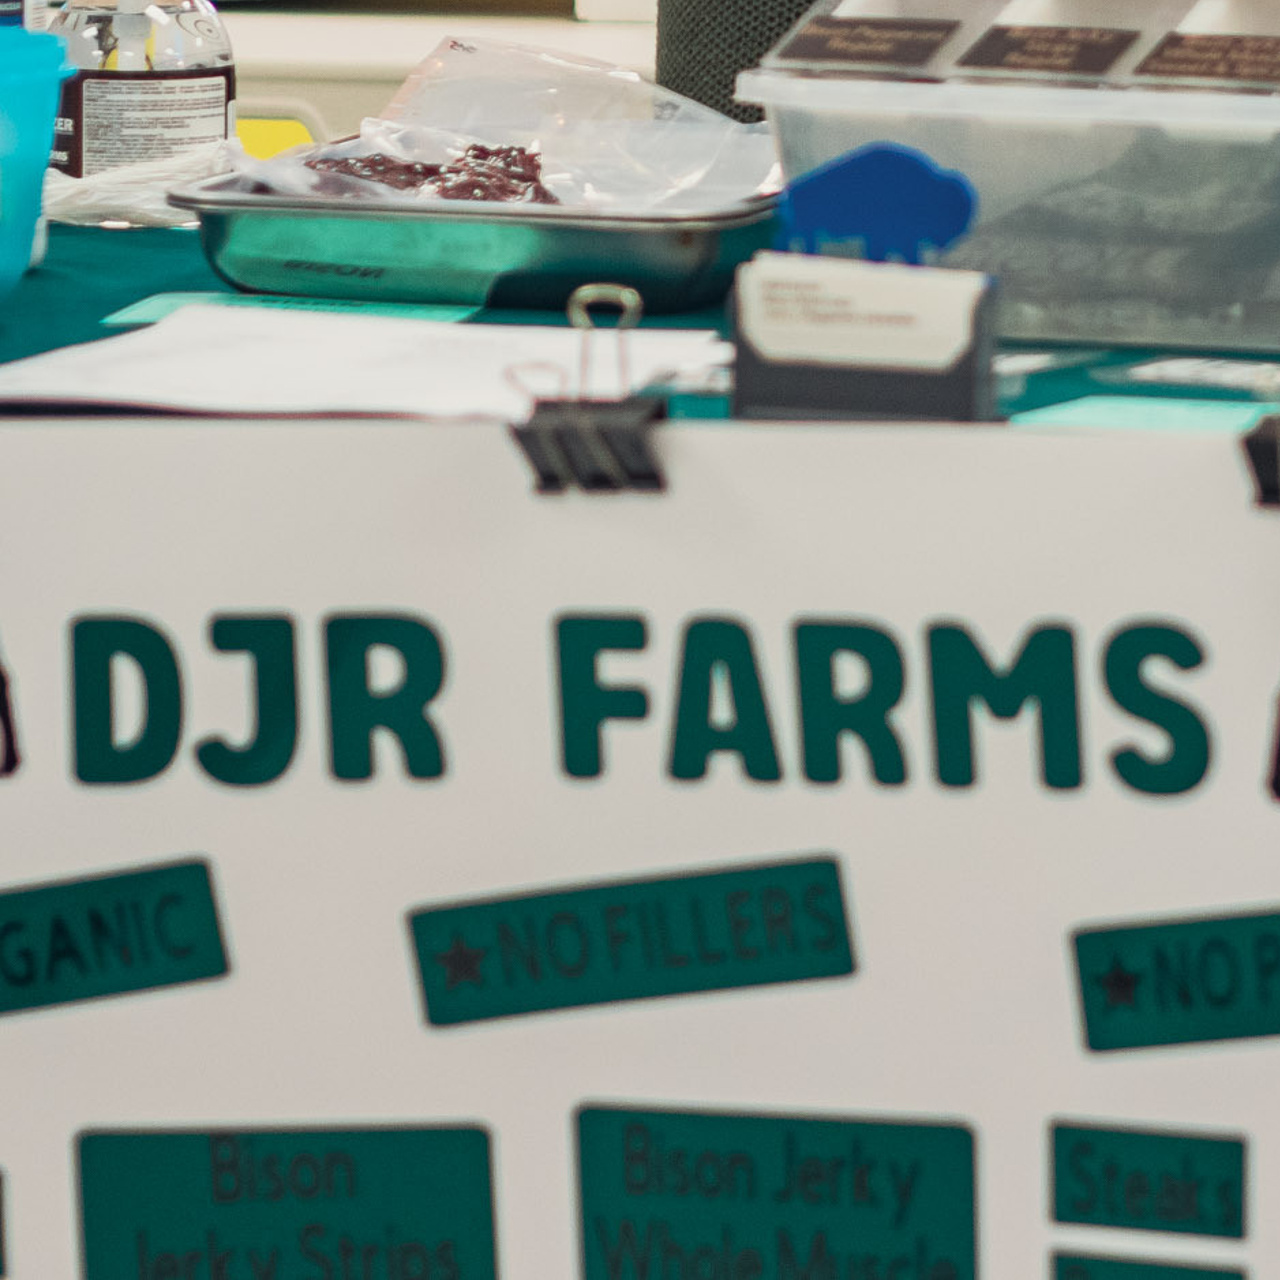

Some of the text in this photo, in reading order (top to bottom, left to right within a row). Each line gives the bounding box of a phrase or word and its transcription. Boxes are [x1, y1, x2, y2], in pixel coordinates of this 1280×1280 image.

[72, 613, 1212, 795] DJR FARMS
[0, 891, 196, 988] GANIC
[496, 881, 841, 986] NO FILLERS
[1151, 936, 1241, 1013] NO
[209, 1133, 356, 1203] Bison
[623, 1122, 919, 1229] Bison Jerky
[1068, 1140, 1238, 1229] Steaks
